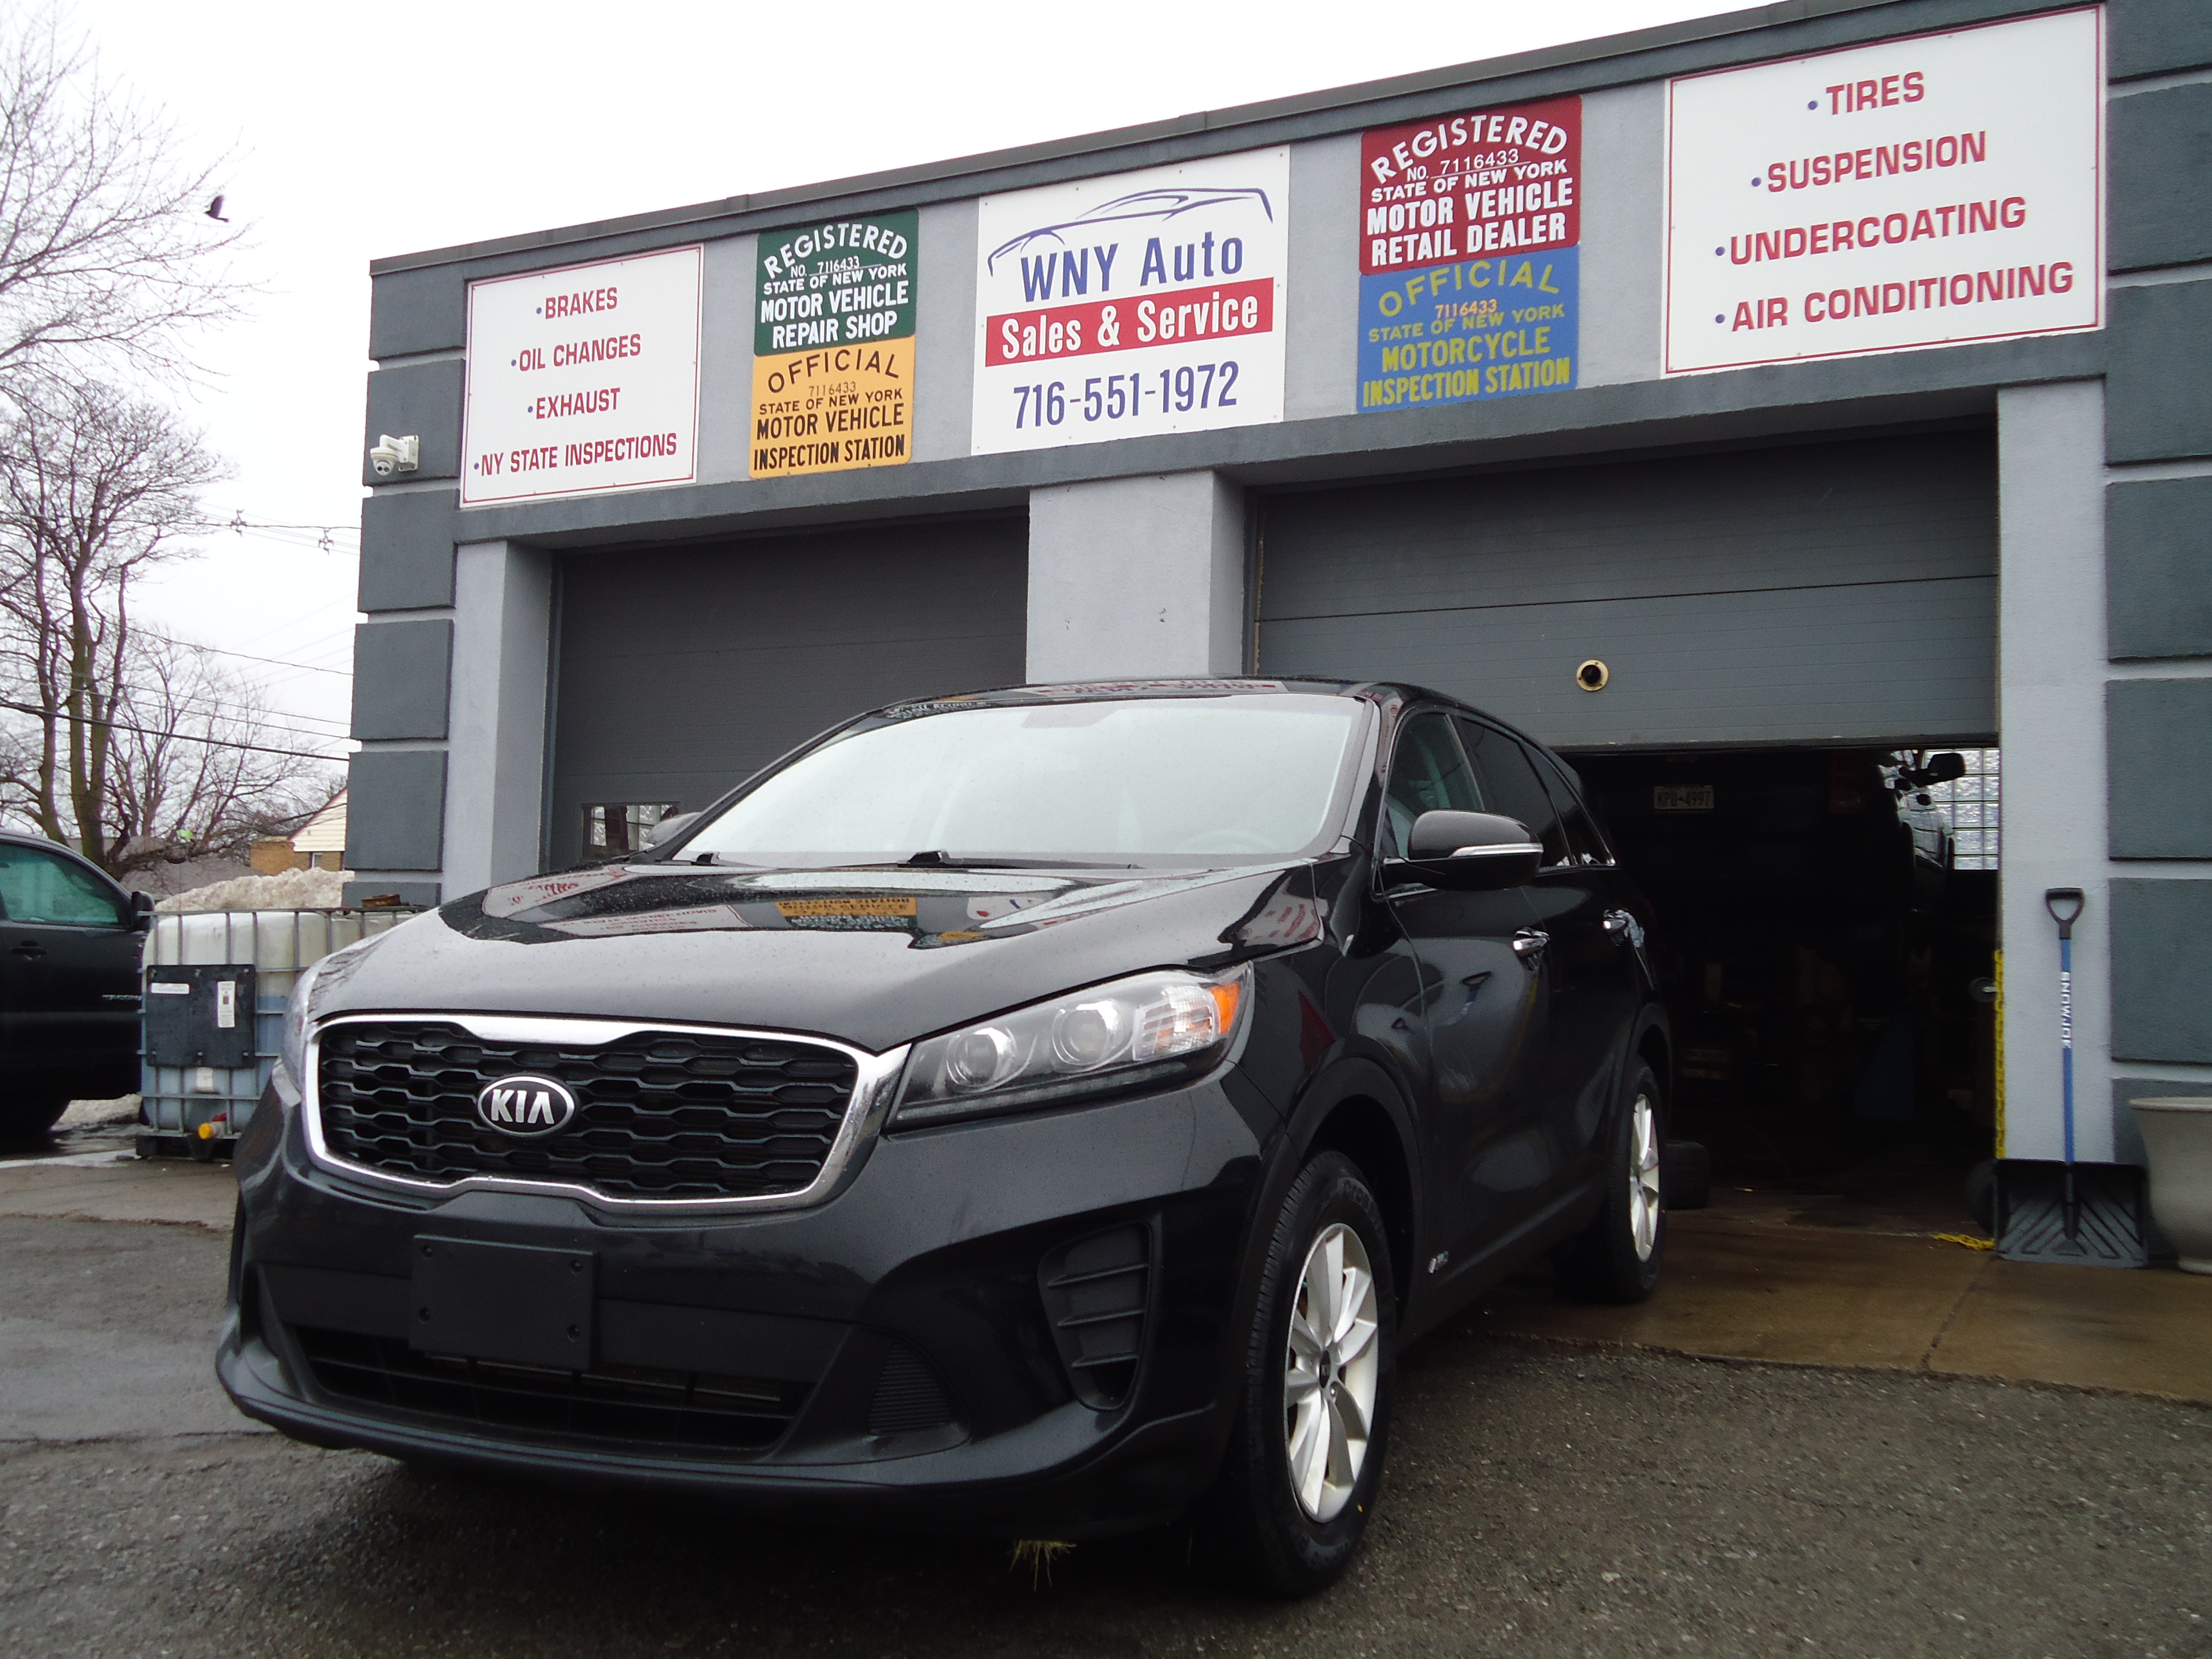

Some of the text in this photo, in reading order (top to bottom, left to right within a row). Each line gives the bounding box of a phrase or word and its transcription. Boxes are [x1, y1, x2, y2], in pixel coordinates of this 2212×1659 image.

[1826, 71, 1924, 115] TIRES
[1371, 115, 1567, 183] REGISTERED
[1440, 148, 1519, 175] 7116433
[1768, 131, 1987, 193] SUSPENSION
[1371, 159, 1567, 203] STATE OF NEW YORK
[1367, 178, 1573, 236] MOTOR VEHICLE
[763, 223, 907, 279] REGISTERED
[1372, 212, 1566, 266] RETAIL DEALER
[1731, 196, 2026, 265] UNDERCOATING
[763, 263, 907, 295] STATE OF NEW YORK
[817, 256, 860, 274] 7116433
[1020, 231, 1243, 303] WNY Auto
[545, 287, 618, 319] BRAKES
[761, 281, 909, 323] MOTOR VEHICLE
[1378, 259, 1560, 316] OFFICIAL
[1435, 298, 1498, 319] 7116433
[1732, 261, 2074, 332] AIR CONDITIONING
[773, 310, 897, 349] REPAIR SHOP
[1002, 291, 1258, 359] Sales & Service
[1369, 304, 1565, 342] STATE OF NEW YORK
[519, 333, 641, 371] OIL CHANGES
[768, 349, 899, 393] OFFICIAL
[1382, 326, 1551, 373] MOTORCYCLE
[759, 388, 903, 415] STATE OF NEW YORK
[809, 381, 856, 397] 7116433
[1013, 361, 1239, 429] 716-551-1972
[1363, 356, 1570, 407] INSPECTION STATION
[536, 388, 620, 419] EXHAUST
[757, 403, 904, 440] MOTOR VEHICLE
[481, 433, 676, 476] NY STATE INSPECTIONS
[754, 434, 905, 471] INSPECTION STATION
[491, 1089, 555, 1124] KIA
